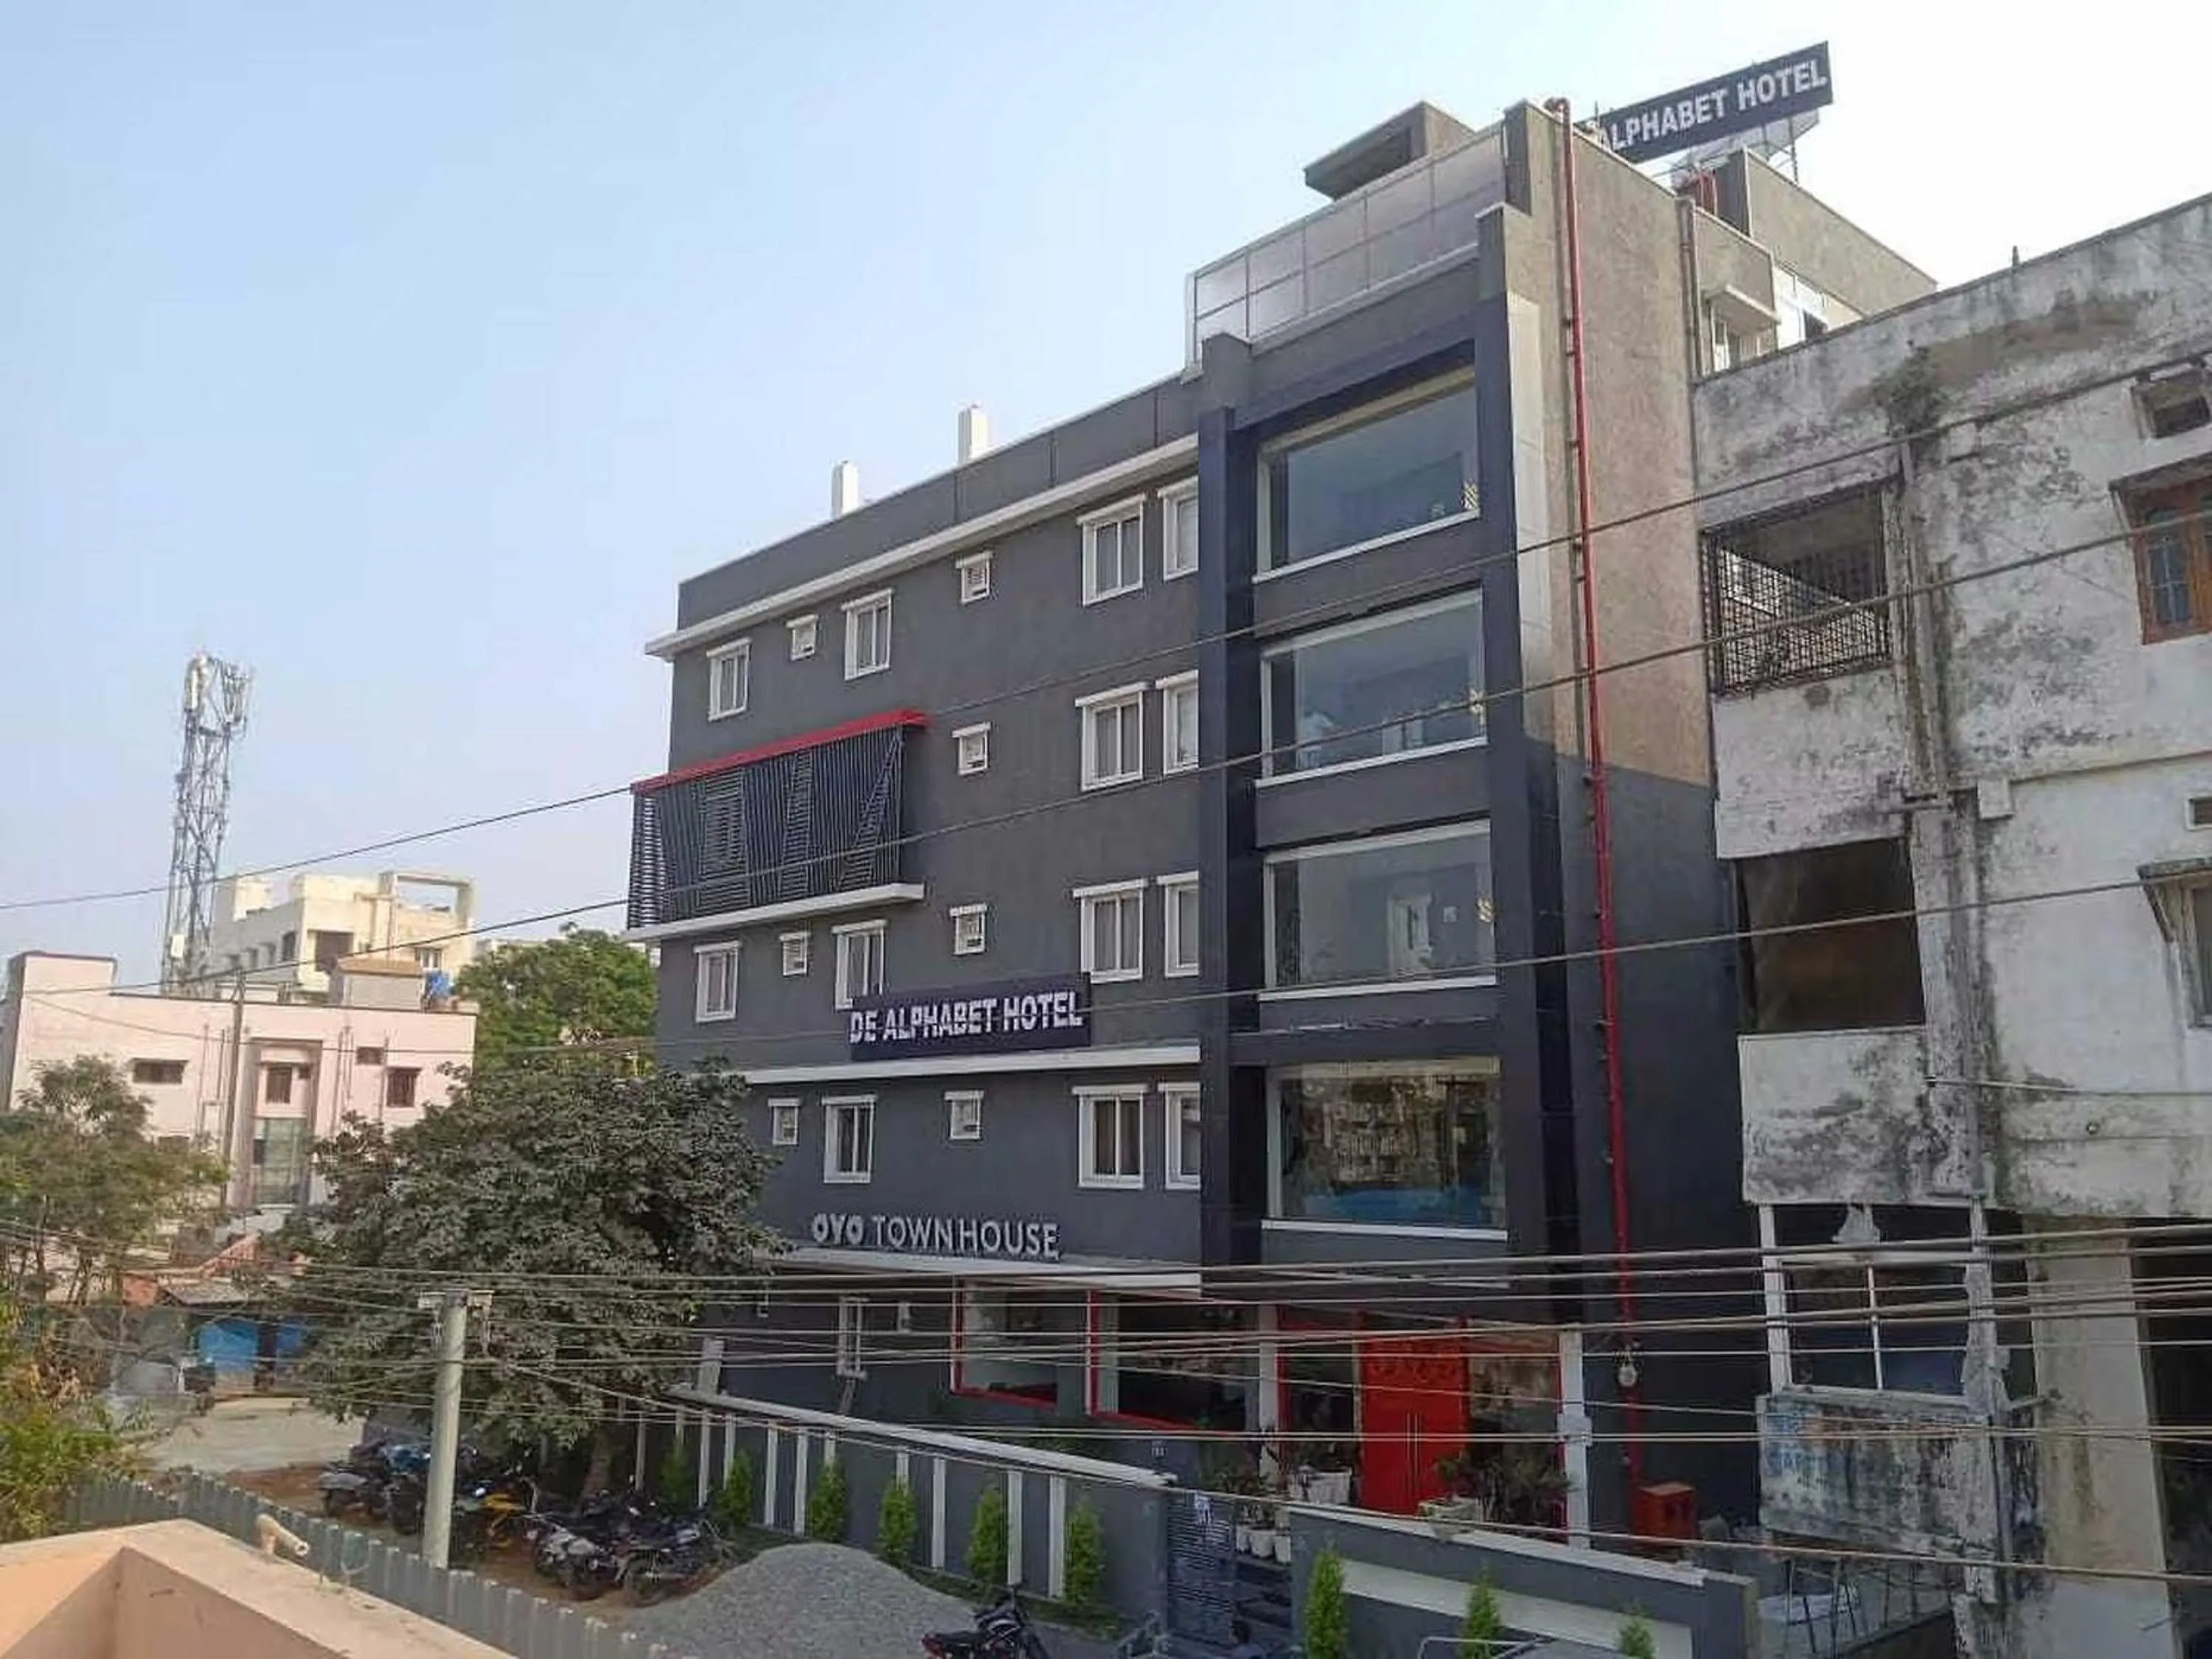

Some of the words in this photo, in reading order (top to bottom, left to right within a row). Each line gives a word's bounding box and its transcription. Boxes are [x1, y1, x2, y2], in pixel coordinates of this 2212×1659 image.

[1736, 59, 1827, 112] HOTEL
[849, 1009, 879, 1044] DE
[883, 998, 998, 1041] ALPHABET
[1002, 991, 1083, 1032] HOTEL
[812, 1213, 863, 1245] OYO
